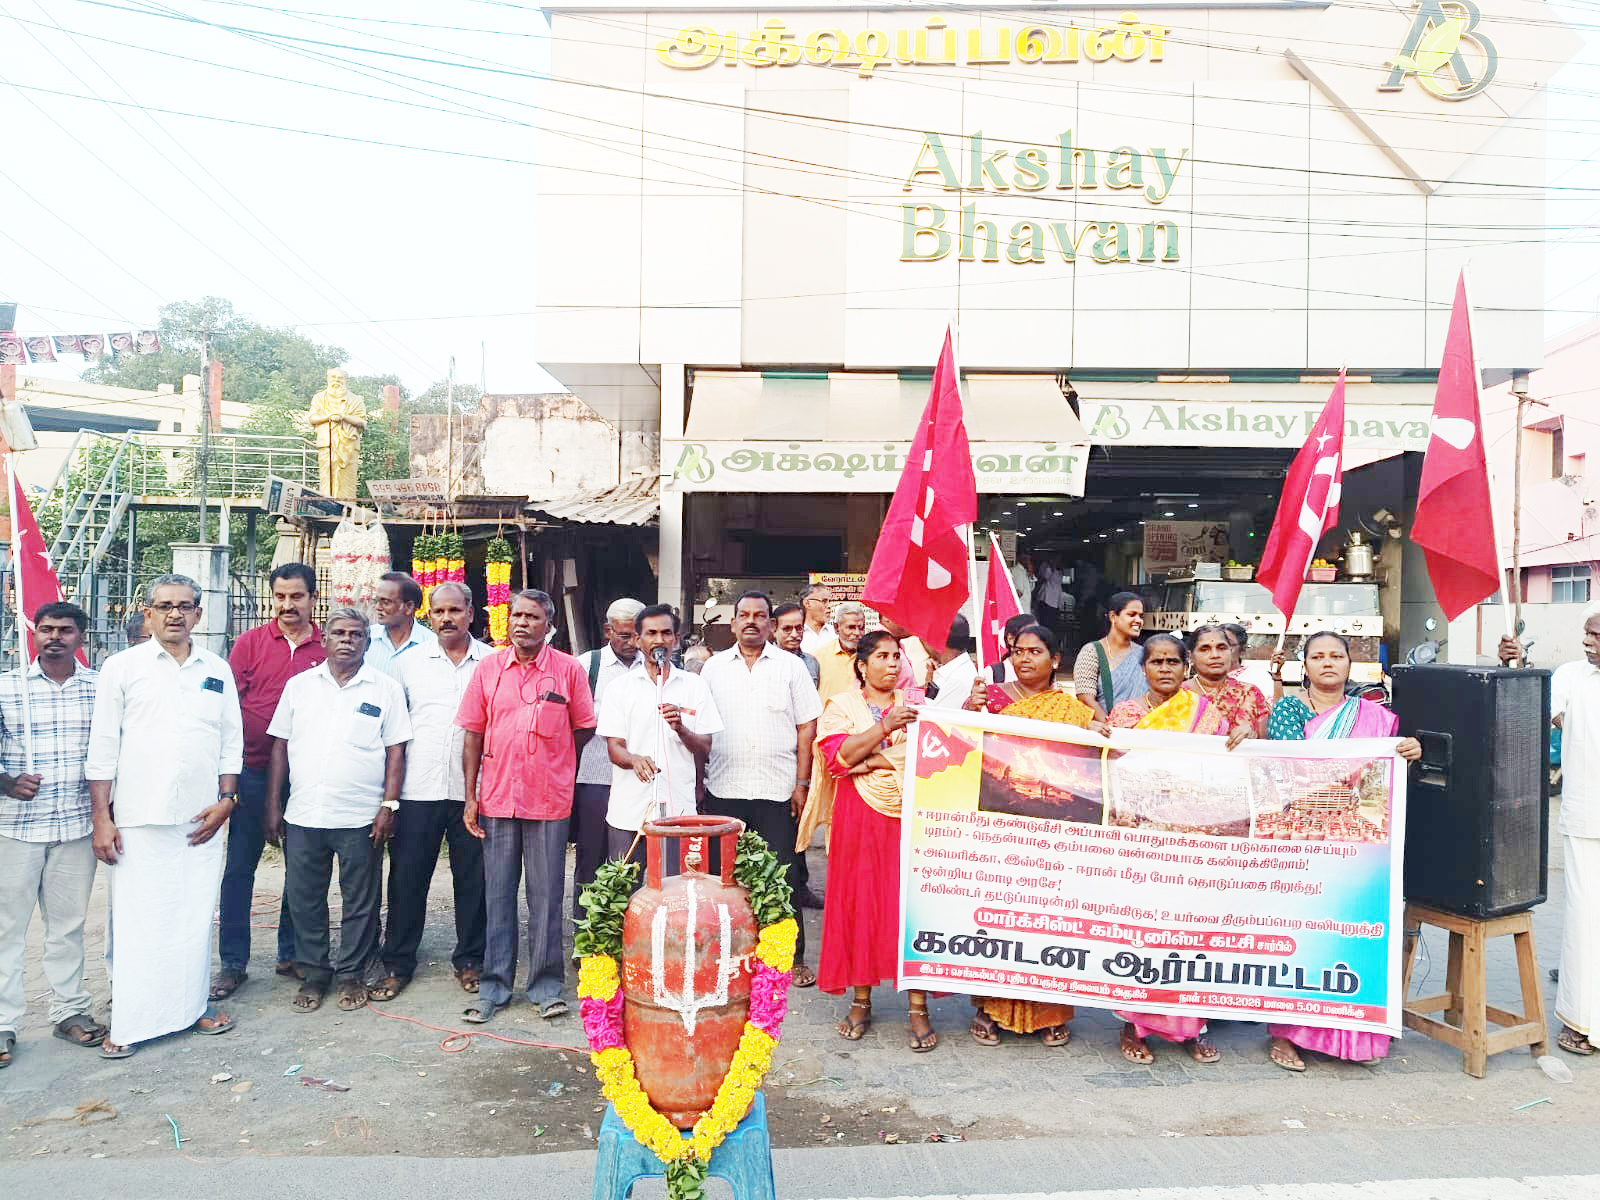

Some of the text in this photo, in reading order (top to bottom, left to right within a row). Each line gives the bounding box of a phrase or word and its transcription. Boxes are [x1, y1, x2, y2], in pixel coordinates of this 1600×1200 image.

[903, 129, 1190, 203] Akshay
[900, 202, 1181, 264] Bhavan
[1142, 405, 1298, 438] Akshay
[924, 825, 962, 839] டிரம்ப்
[1053, 840, 1115, 857] கும்பலை
[1117, 847, 1204, 865] வன்மையாக
[992, 816, 1062, 835] குண்டுவீசி
[1064, 825, 1121, 841] அப்பாவி
[1124, 832, 1228, 852] பொதுமக்களை
[1230, 841, 1302, 855] படுகொலை
[1304, 843, 1358, 860] செய்யும்
[921, 865, 1062, 892] ஒன்றிய மோடி அரசே!
[1004, 853, 1065, 872] இஸ்ரேல்
[1076, 864, 1117, 879] ஈரான்
[1120, 868, 1147, 884] மீது
[1150, 870, 1184, 885] போர்
[1187, 876, 1268, 892] தொடுப்பதை
[1270, 880, 1322, 896] நிறுத்து!
[920, 881, 981, 899] சிலிண்டர்
[1161, 910, 1220, 924] உயர்வை
[977, 909, 1293, 953] மார்க்சிஸ்ட் கம்யூனிஸ்ட் கட்சி சார்பில்
[913, 929, 1359, 994] கண்டன ஆர்ப்பாட்டம்
[1207, 995, 1261, 1008] 13.03.2026
[1263, 1000, 1295, 1011] மாலை
[1296, 1002, 1321, 1014] 5.00
